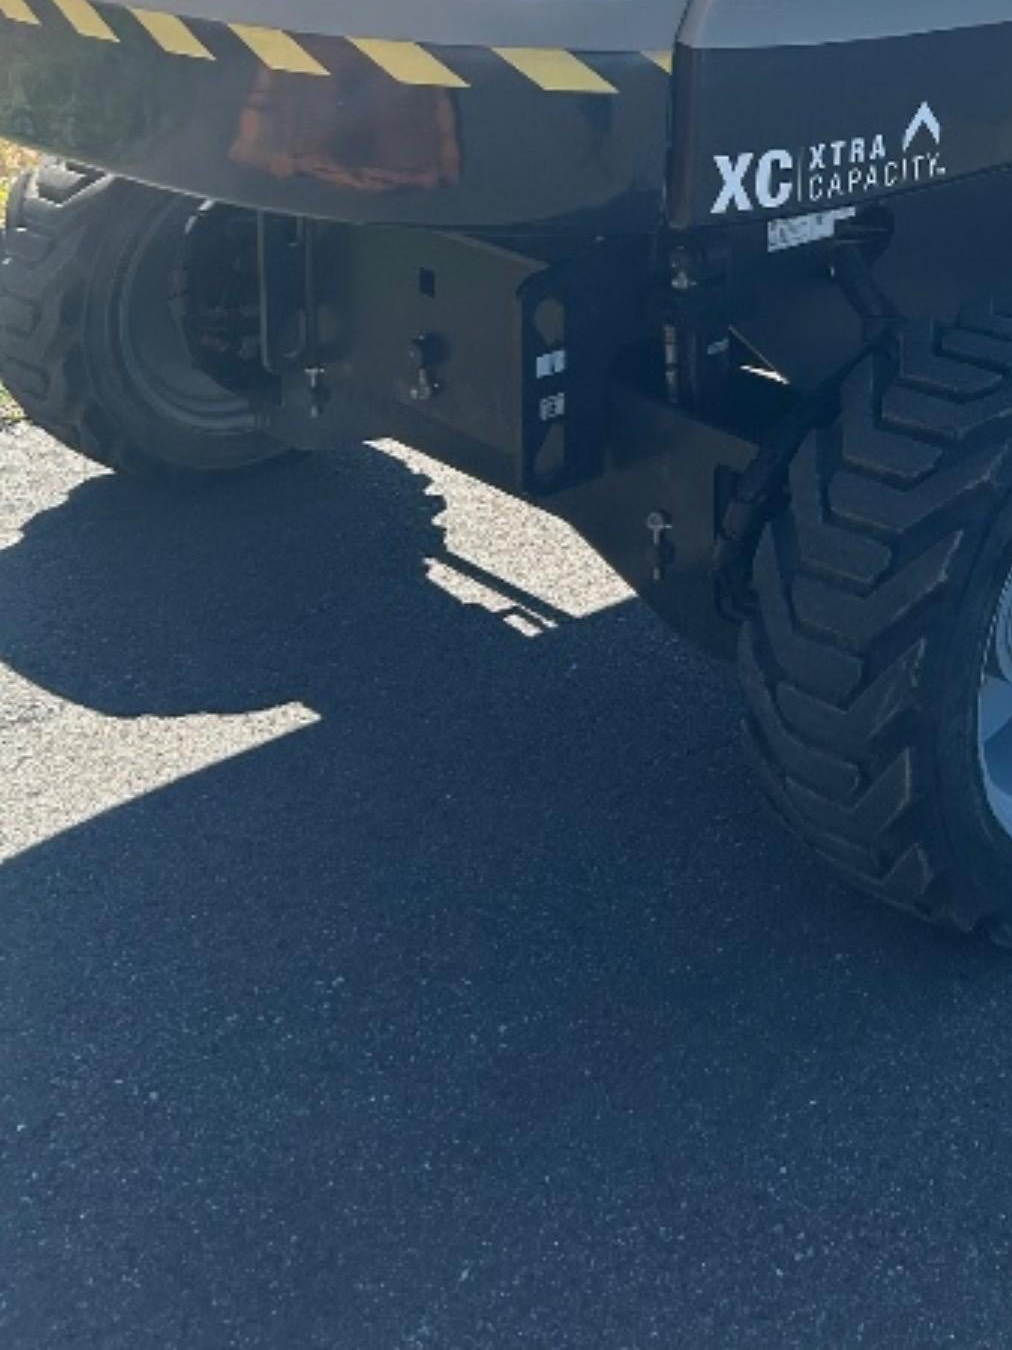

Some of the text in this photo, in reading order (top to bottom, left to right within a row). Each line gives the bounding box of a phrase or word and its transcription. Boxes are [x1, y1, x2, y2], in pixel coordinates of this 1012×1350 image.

[808, 134, 886, 170] XTRA
[710, 149, 794, 214] XC
[808, 153, 941, 202] CAPACITY
